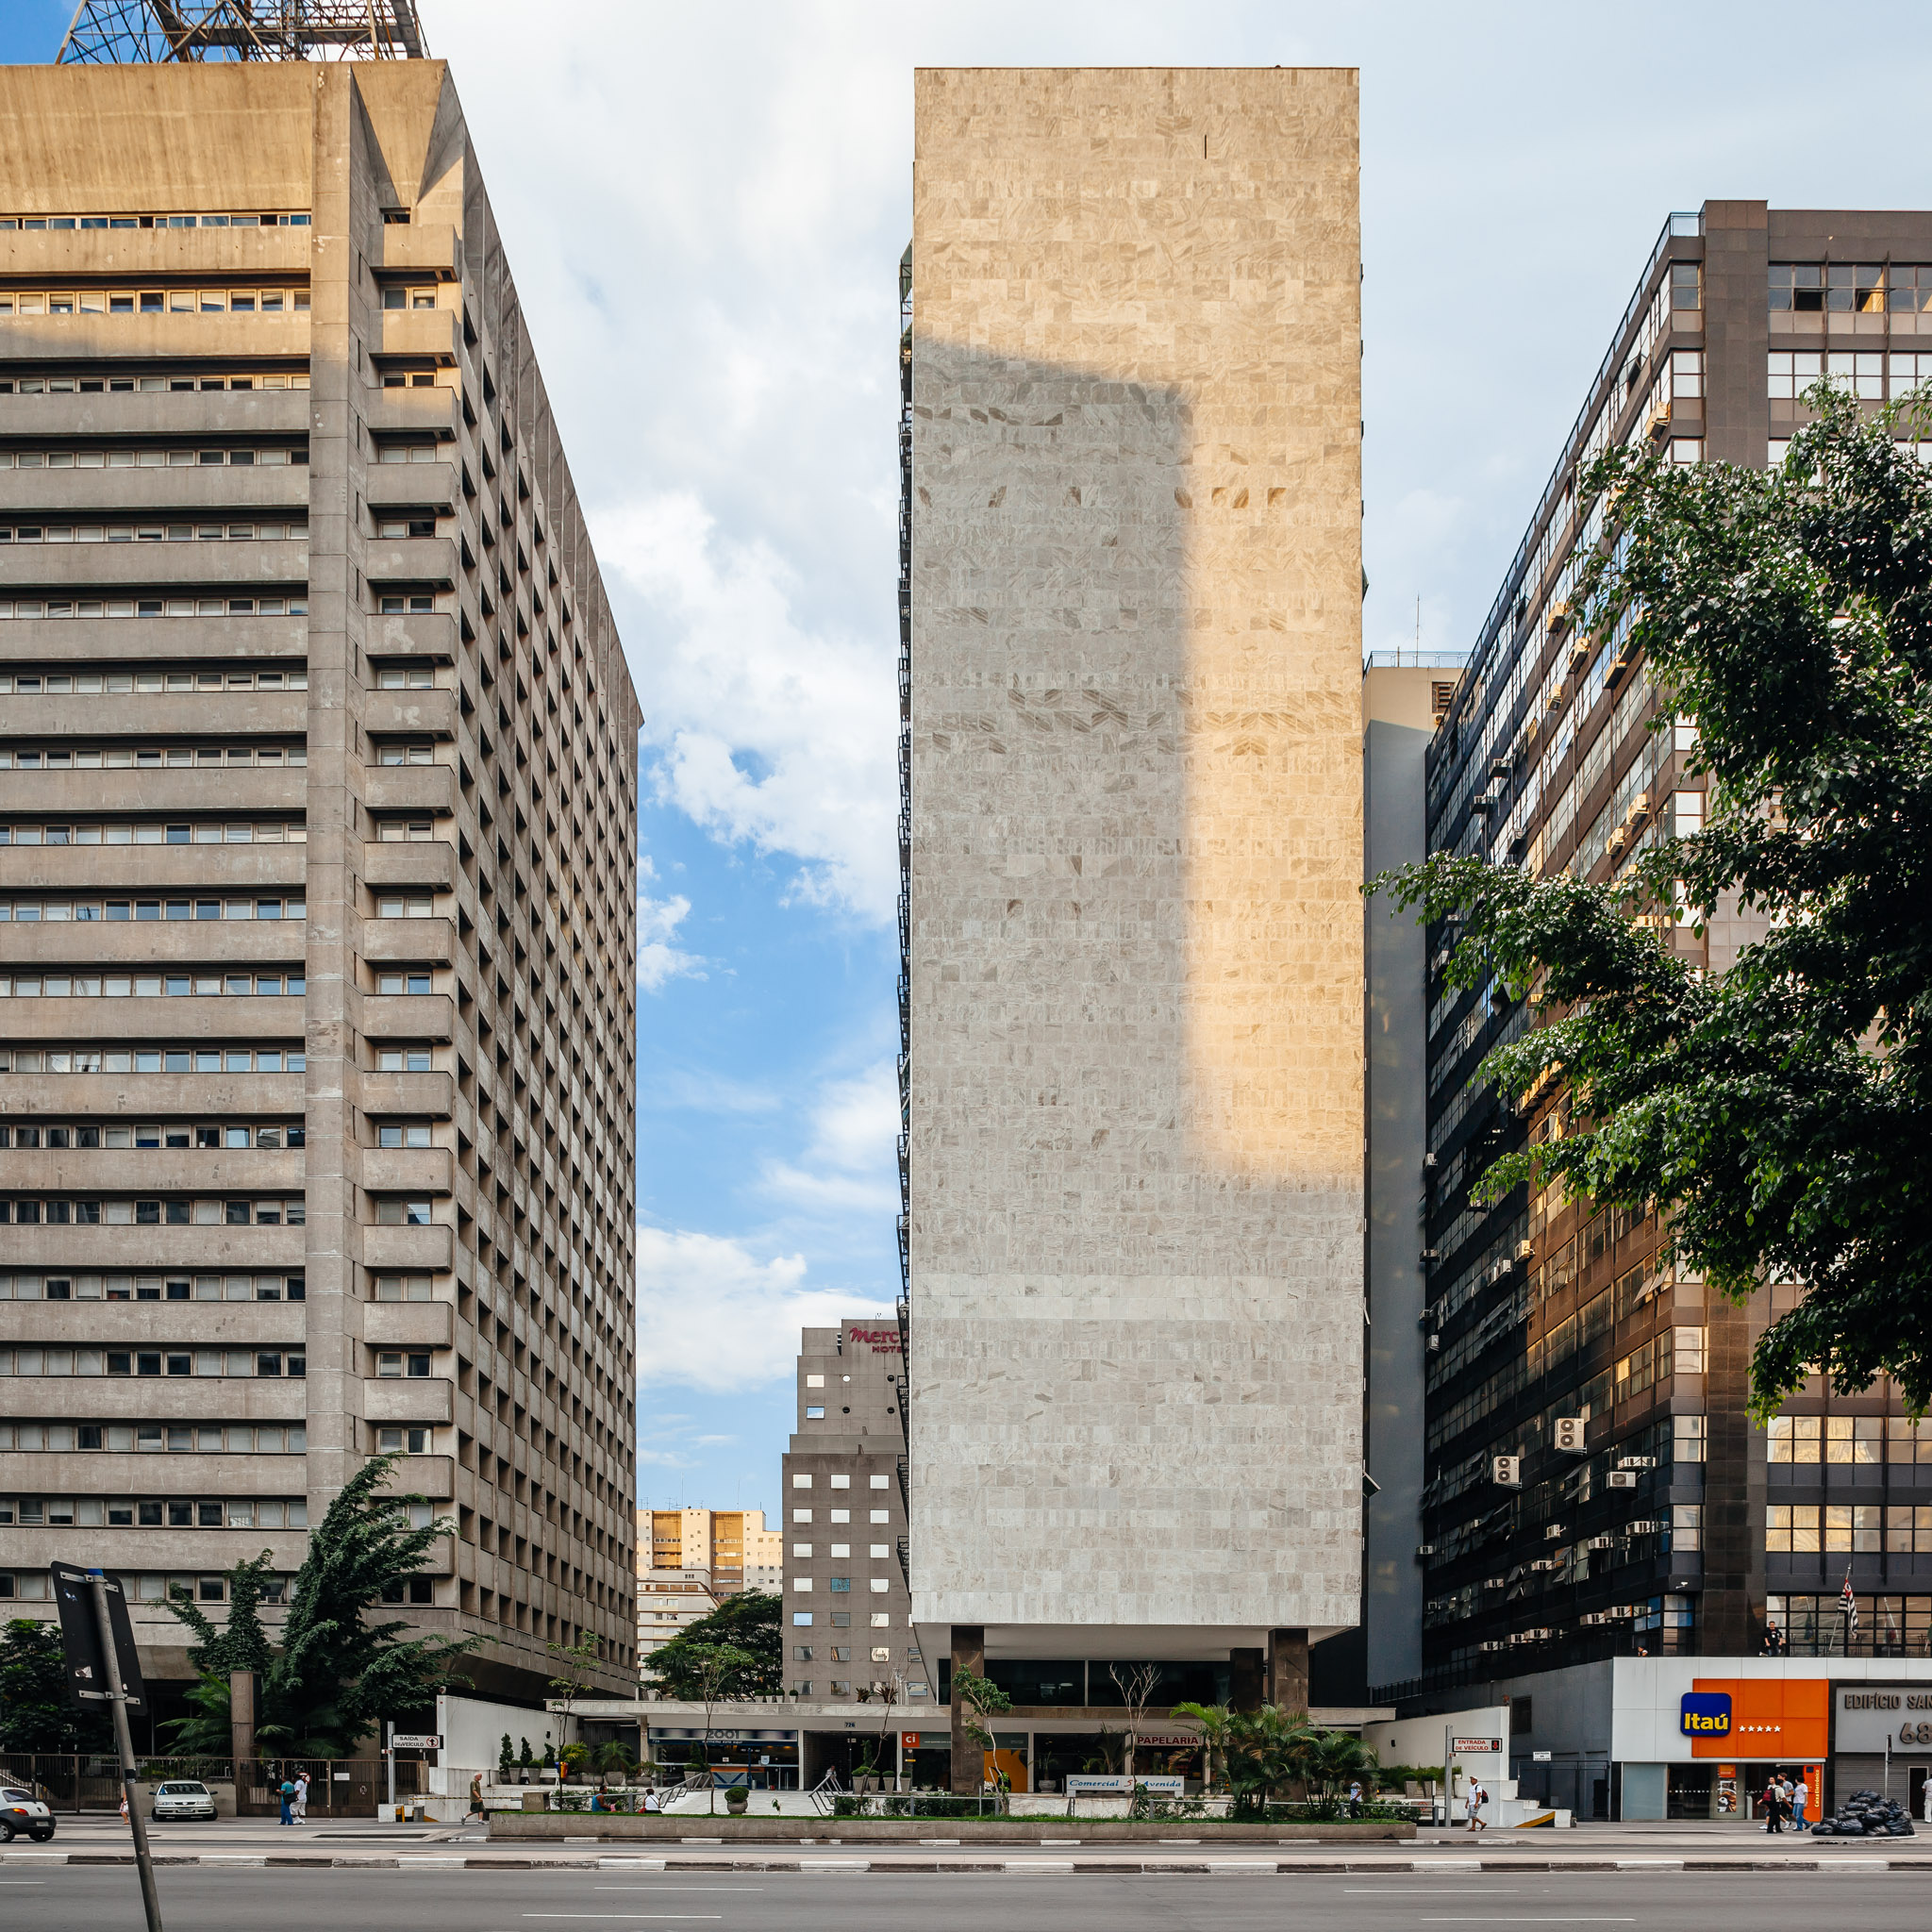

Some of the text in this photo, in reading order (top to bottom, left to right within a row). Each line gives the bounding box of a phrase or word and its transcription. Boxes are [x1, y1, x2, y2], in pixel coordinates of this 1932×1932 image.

[1844, 1691, 1901, 1709] EDIFÍCIO
[1684, 1712, 1728, 1730] Itaú
[906, 1733, 916, 1743] ci
[1137, 1736, 1199, 1744] PAPELARIA
